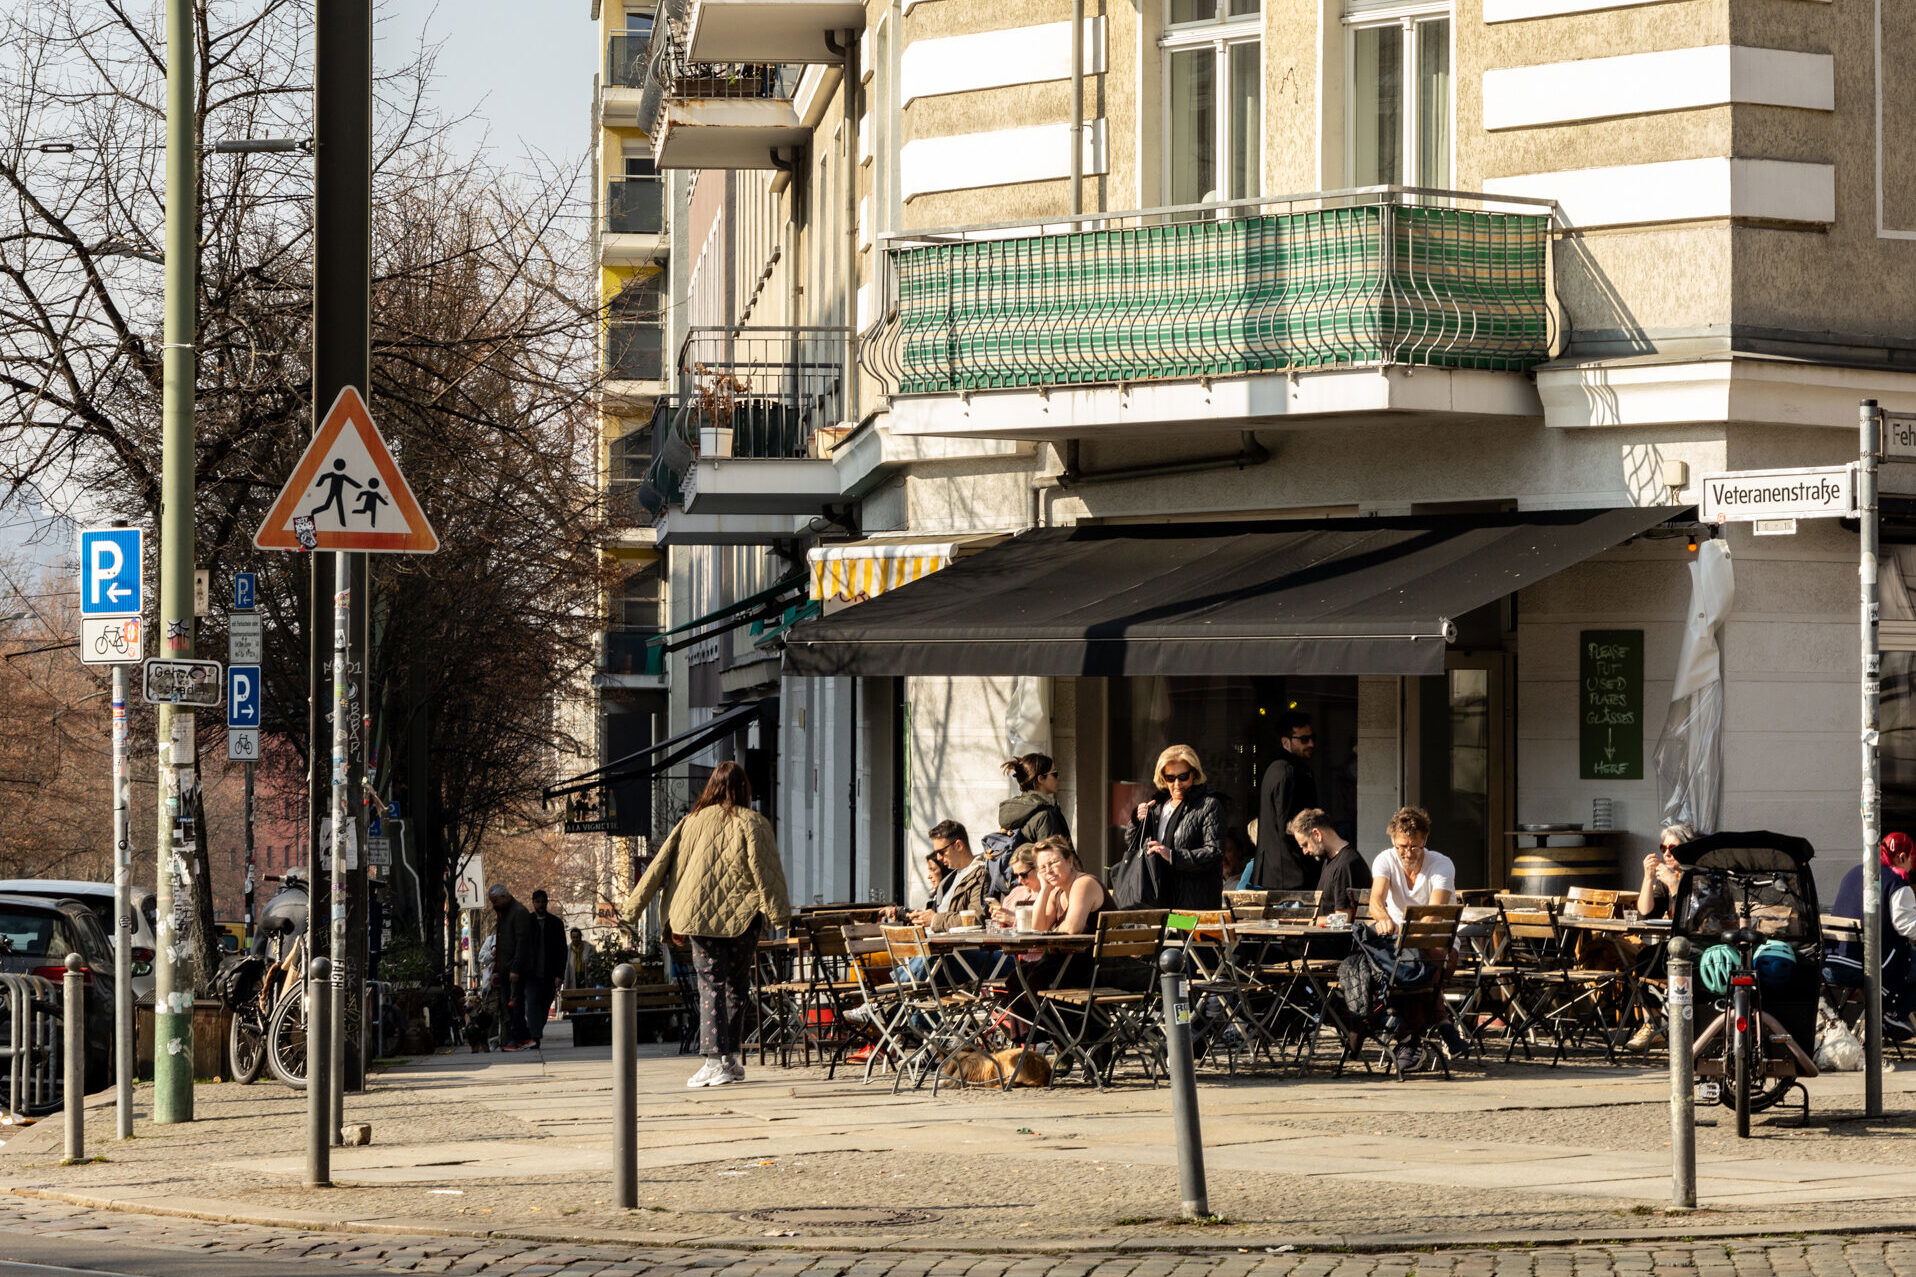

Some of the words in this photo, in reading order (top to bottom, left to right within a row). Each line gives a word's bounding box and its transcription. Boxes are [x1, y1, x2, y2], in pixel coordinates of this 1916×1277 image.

[1713, 478, 1840, 505] Veteranenstraße
[91, 540, 123, 604] P
[238, 578, 249, 604] P
[1588, 642, 1630, 659] PLEASE
[1596, 661, 1622, 675] PUT
[1586, 676, 1627, 691] USED
[233, 675, 250, 718] P
[1590, 692, 1627, 706] PLATES
[1586, 711, 1634, 725] GLASSES
[1594, 761, 1629, 775] HERE
